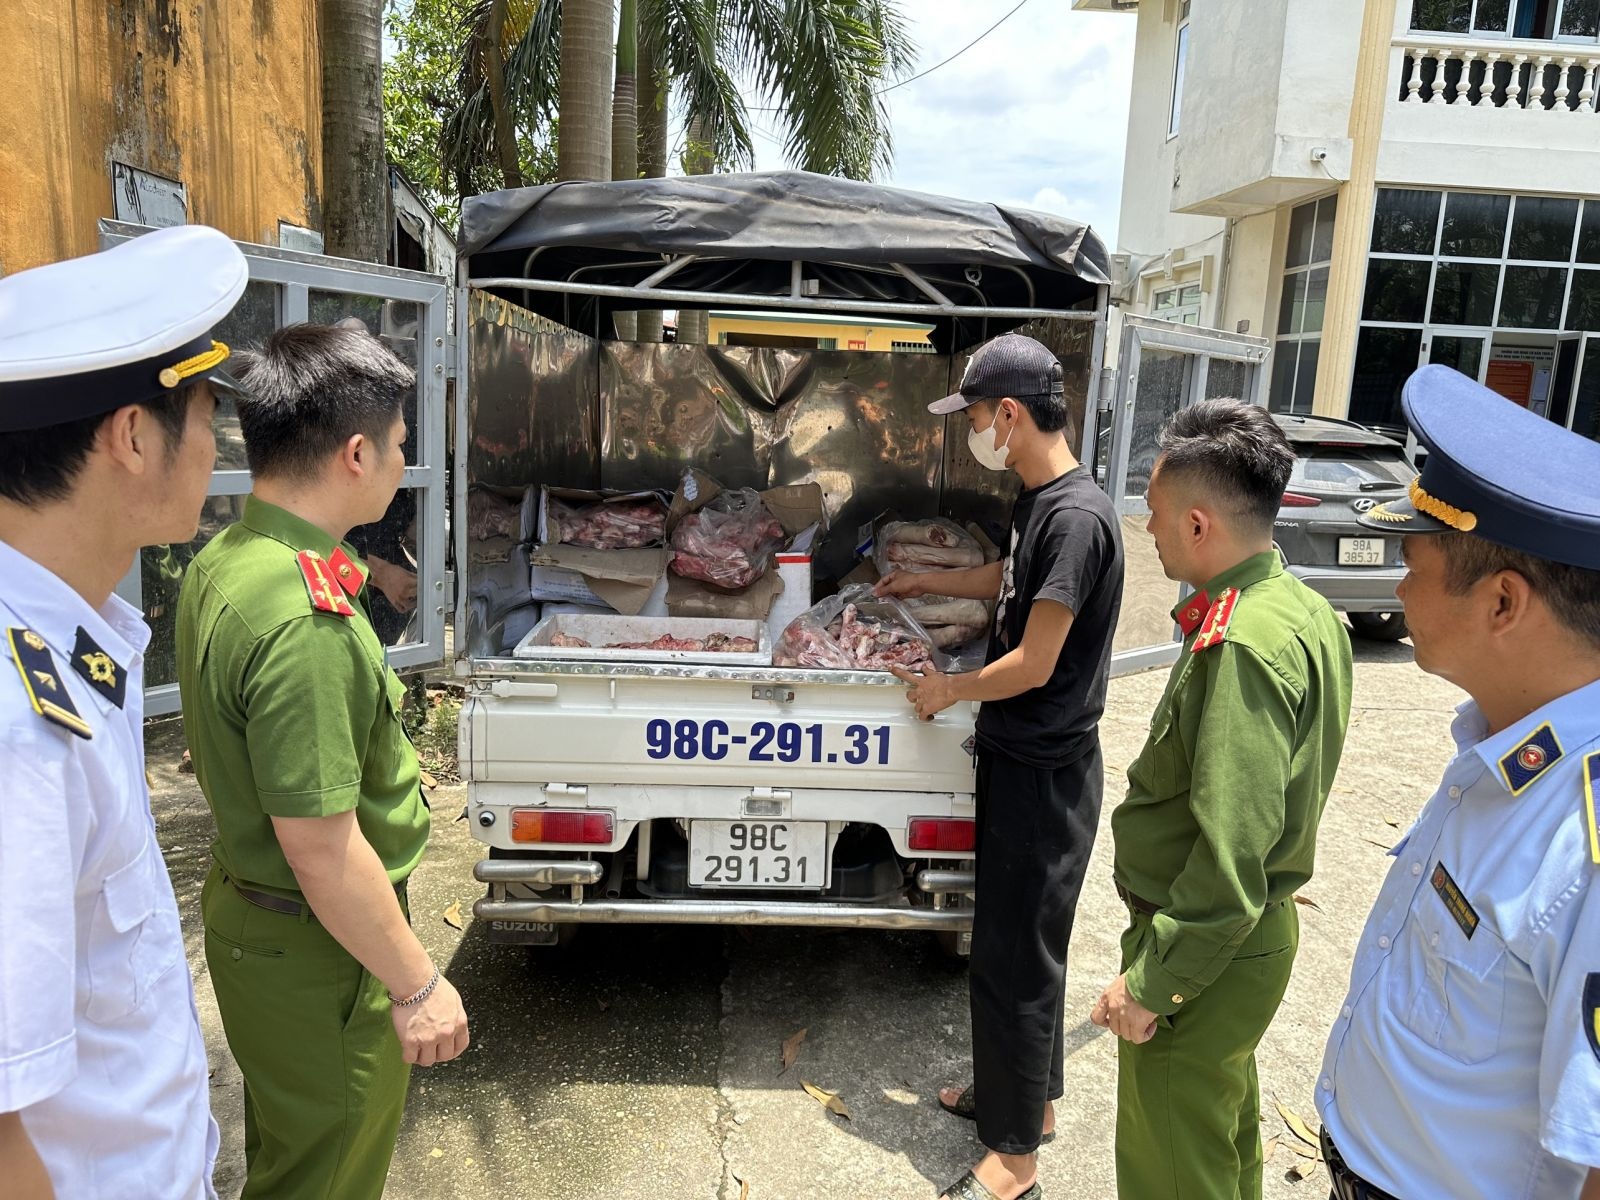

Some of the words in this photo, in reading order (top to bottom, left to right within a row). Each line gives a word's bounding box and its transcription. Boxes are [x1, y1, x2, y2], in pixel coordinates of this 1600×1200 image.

[1352, 540, 1372, 551] 98A
[1344, 552, 1380, 563] 385.37
[646, 718, 890, 765] 98C-291.31
[729, 823, 788, 851] 98C
[704, 855, 808, 883] 291.31
[492, 921, 554, 932] SUZUKI
